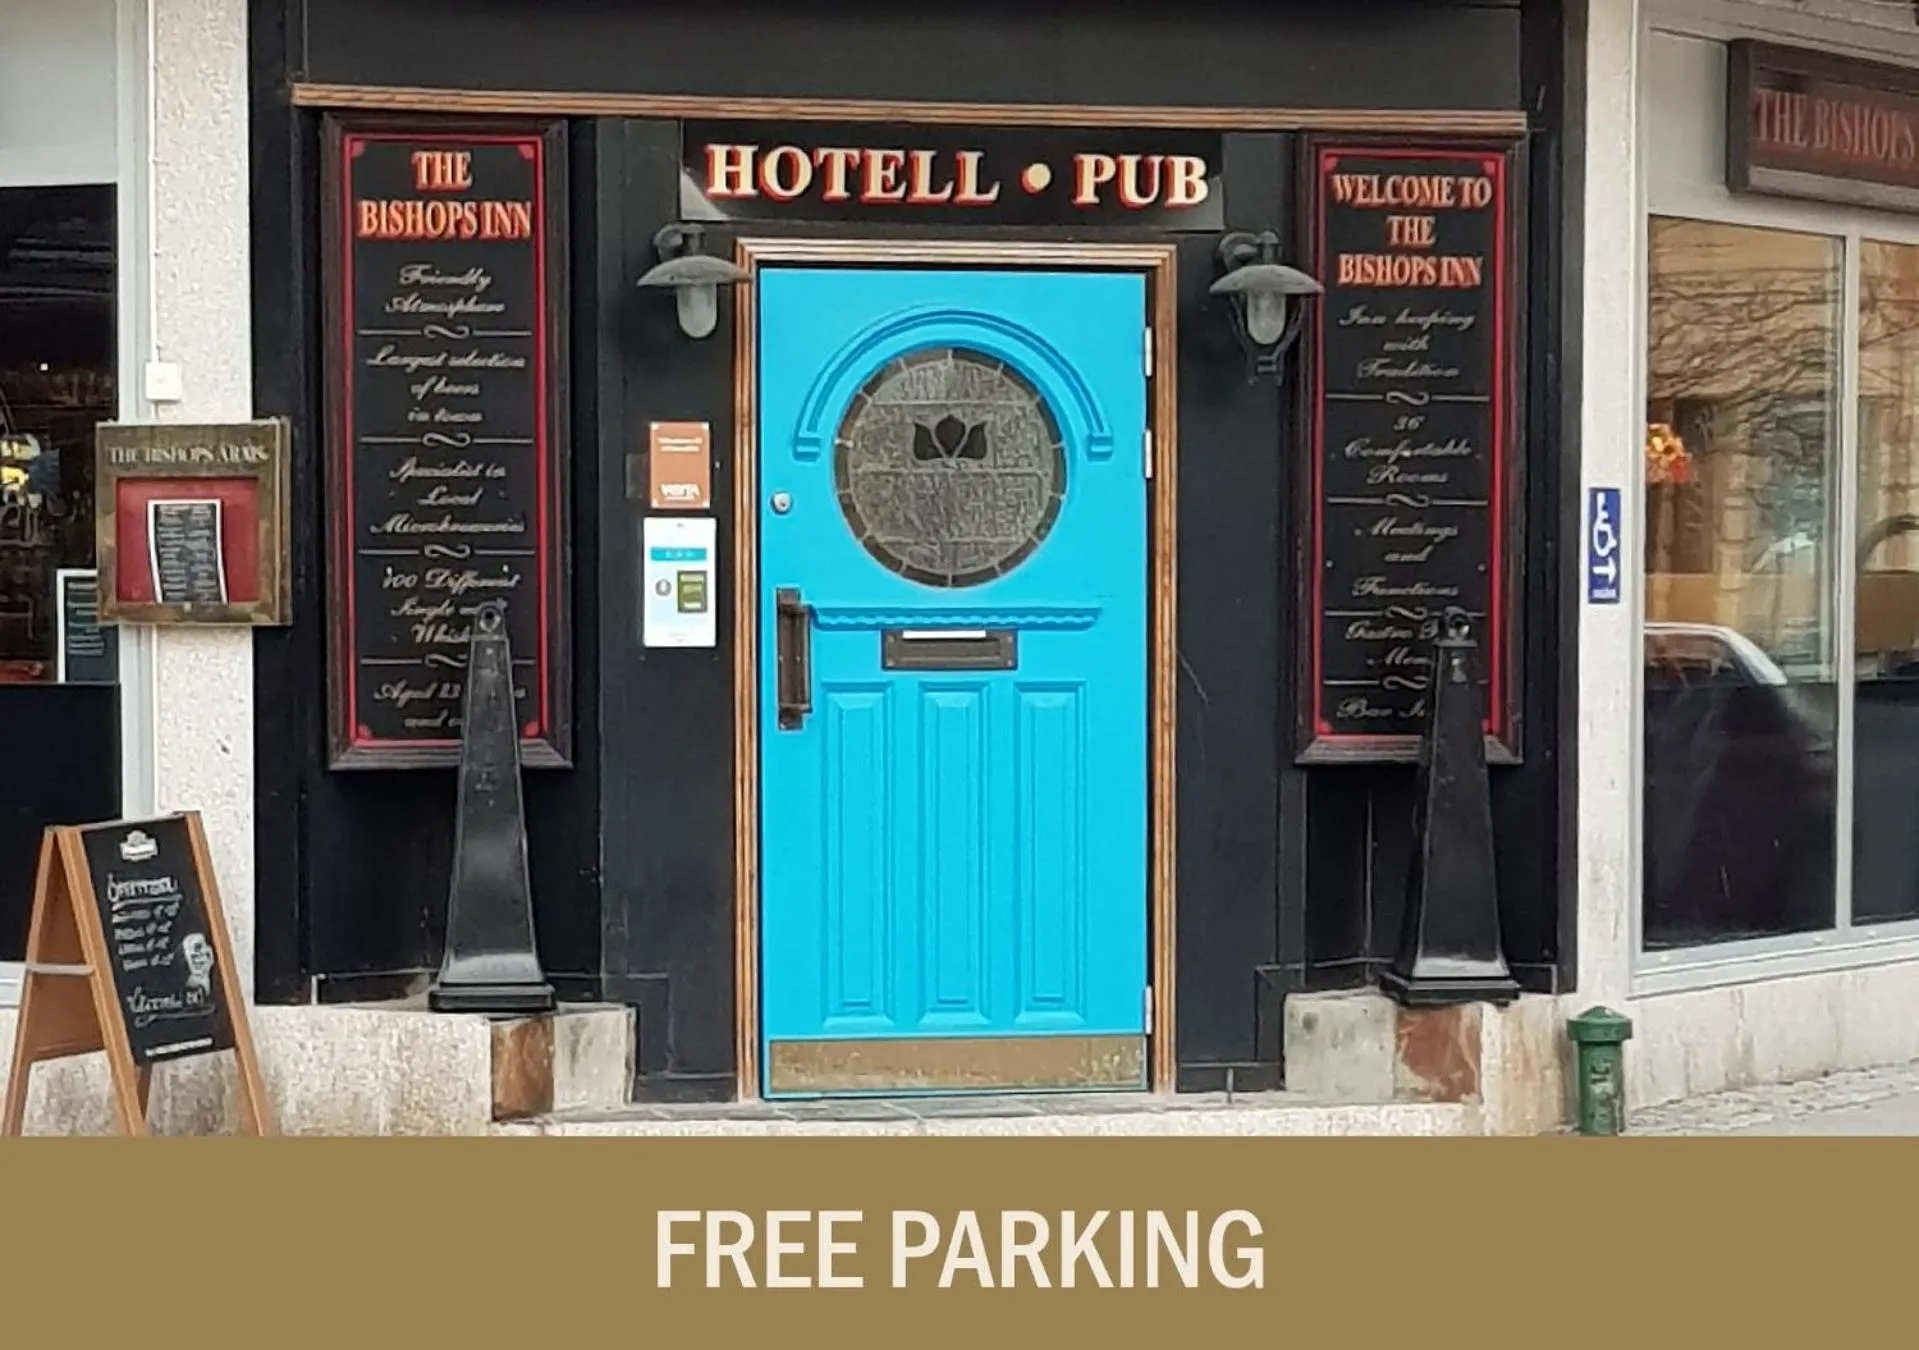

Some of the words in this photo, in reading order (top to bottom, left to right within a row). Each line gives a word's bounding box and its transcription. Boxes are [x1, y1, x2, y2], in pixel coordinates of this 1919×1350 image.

[1754, 87, 1808, 146] THE
[1813, 97, 1917, 164] BISHOPS
[412, 150, 473, 190] THE
[703, 143, 1000, 206] HOTELL
[1073, 153, 1210, 209] PUB
[1331, 173, 1456, 208] WELCOME
[1459, 175, 1493, 209] TO
[356, 199, 478, 240] BISHOPS
[478, 201, 533, 240] INN
[1386, 214, 1437, 247] THE
[399, 263, 492, 293] Friendly
[1337, 253, 1438, 287] BISHOPS
[1439, 256, 1484, 287] INN
[410, 375, 438, 401] of
[407, 406, 430, 422] in
